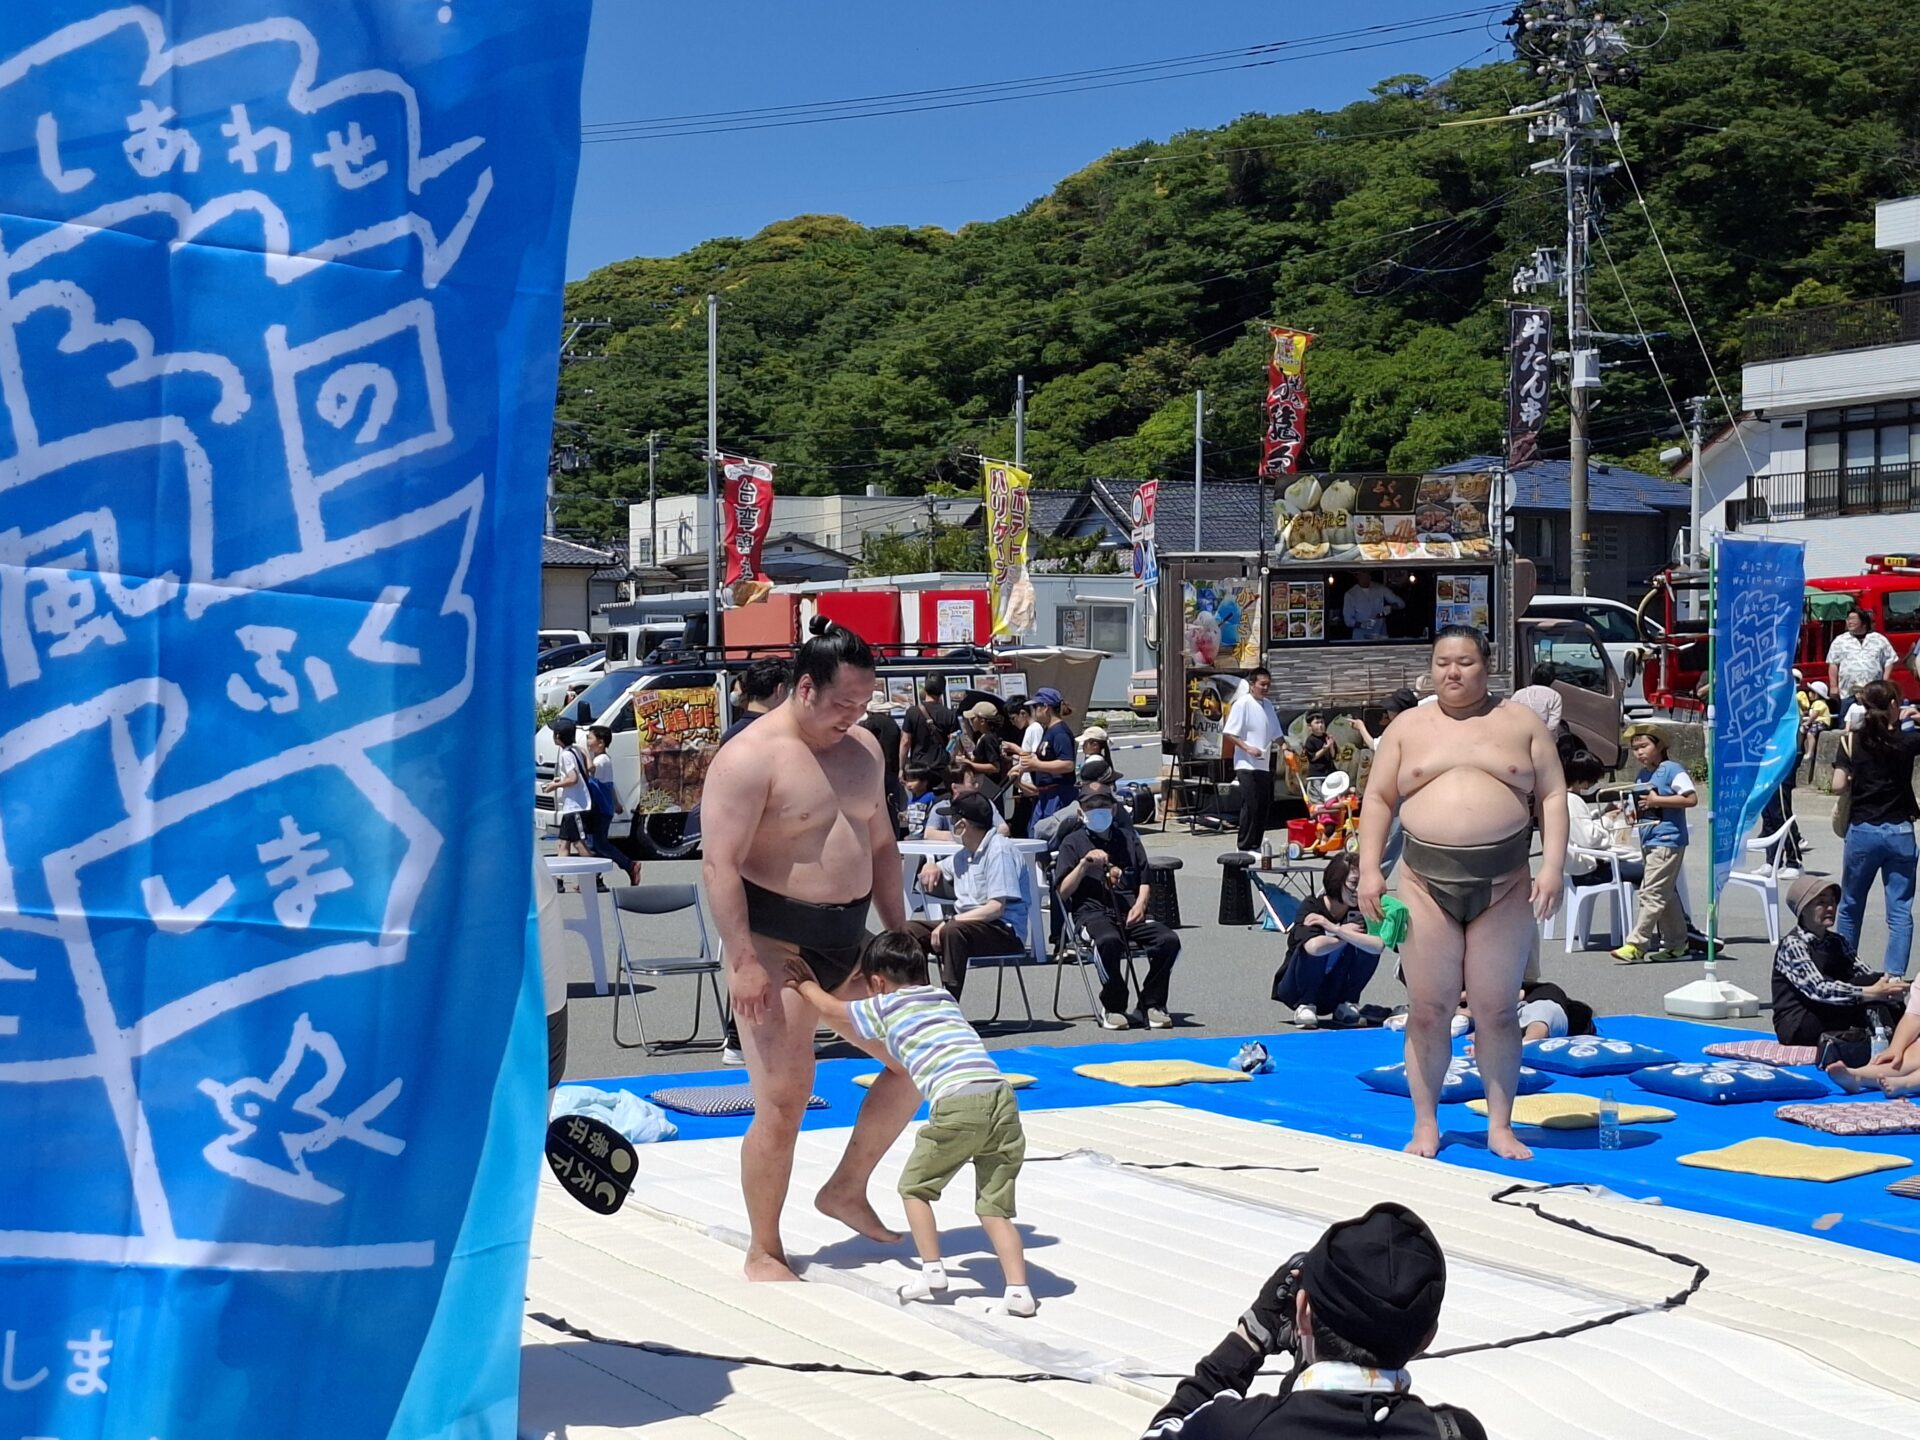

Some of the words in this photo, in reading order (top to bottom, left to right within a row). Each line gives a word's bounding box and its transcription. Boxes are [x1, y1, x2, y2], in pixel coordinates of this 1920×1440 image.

[36, 99, 389, 193] しあわせ
[315, 361, 399, 445] の
[1520, 314, 1547, 427] 牛たん串
[990, 468, 1009, 585] ハリケーン
[226, 586, 421, 713] ふく
[140, 815, 354, 933] しま
[552, 1152, 597, 1193] 天下
